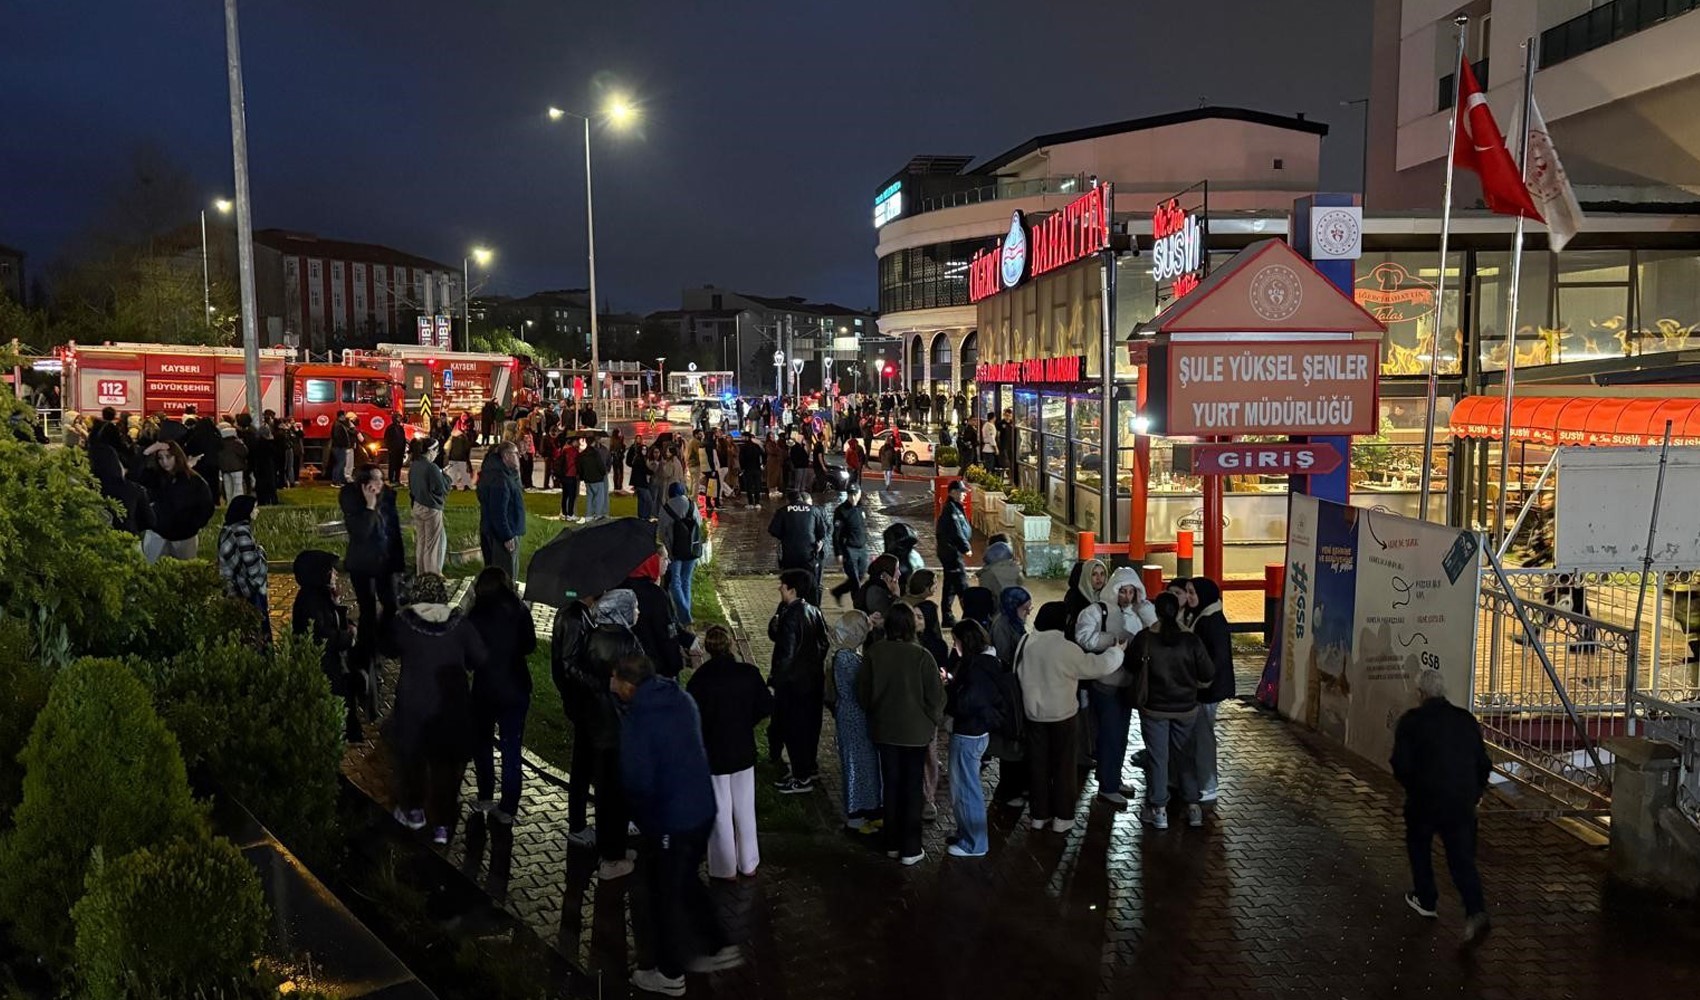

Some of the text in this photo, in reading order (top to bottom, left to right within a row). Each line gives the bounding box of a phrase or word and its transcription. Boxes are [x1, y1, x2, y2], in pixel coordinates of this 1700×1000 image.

[1373, 306, 1404, 321] Talas
[161, 364, 200, 373] KAYSERİ
[450, 361, 477, 371] KAYSERİ
[1179, 350, 1368, 389] ŞULE YÜKSEL ŞENLER
[101, 382, 124, 395] 112
[150, 383, 211, 393] BÜYÜKŞEHİR
[1192, 395, 1353, 427] YURT MÜDÜRLÜĞÜ
[1421, 651, 1440, 670] GSB
